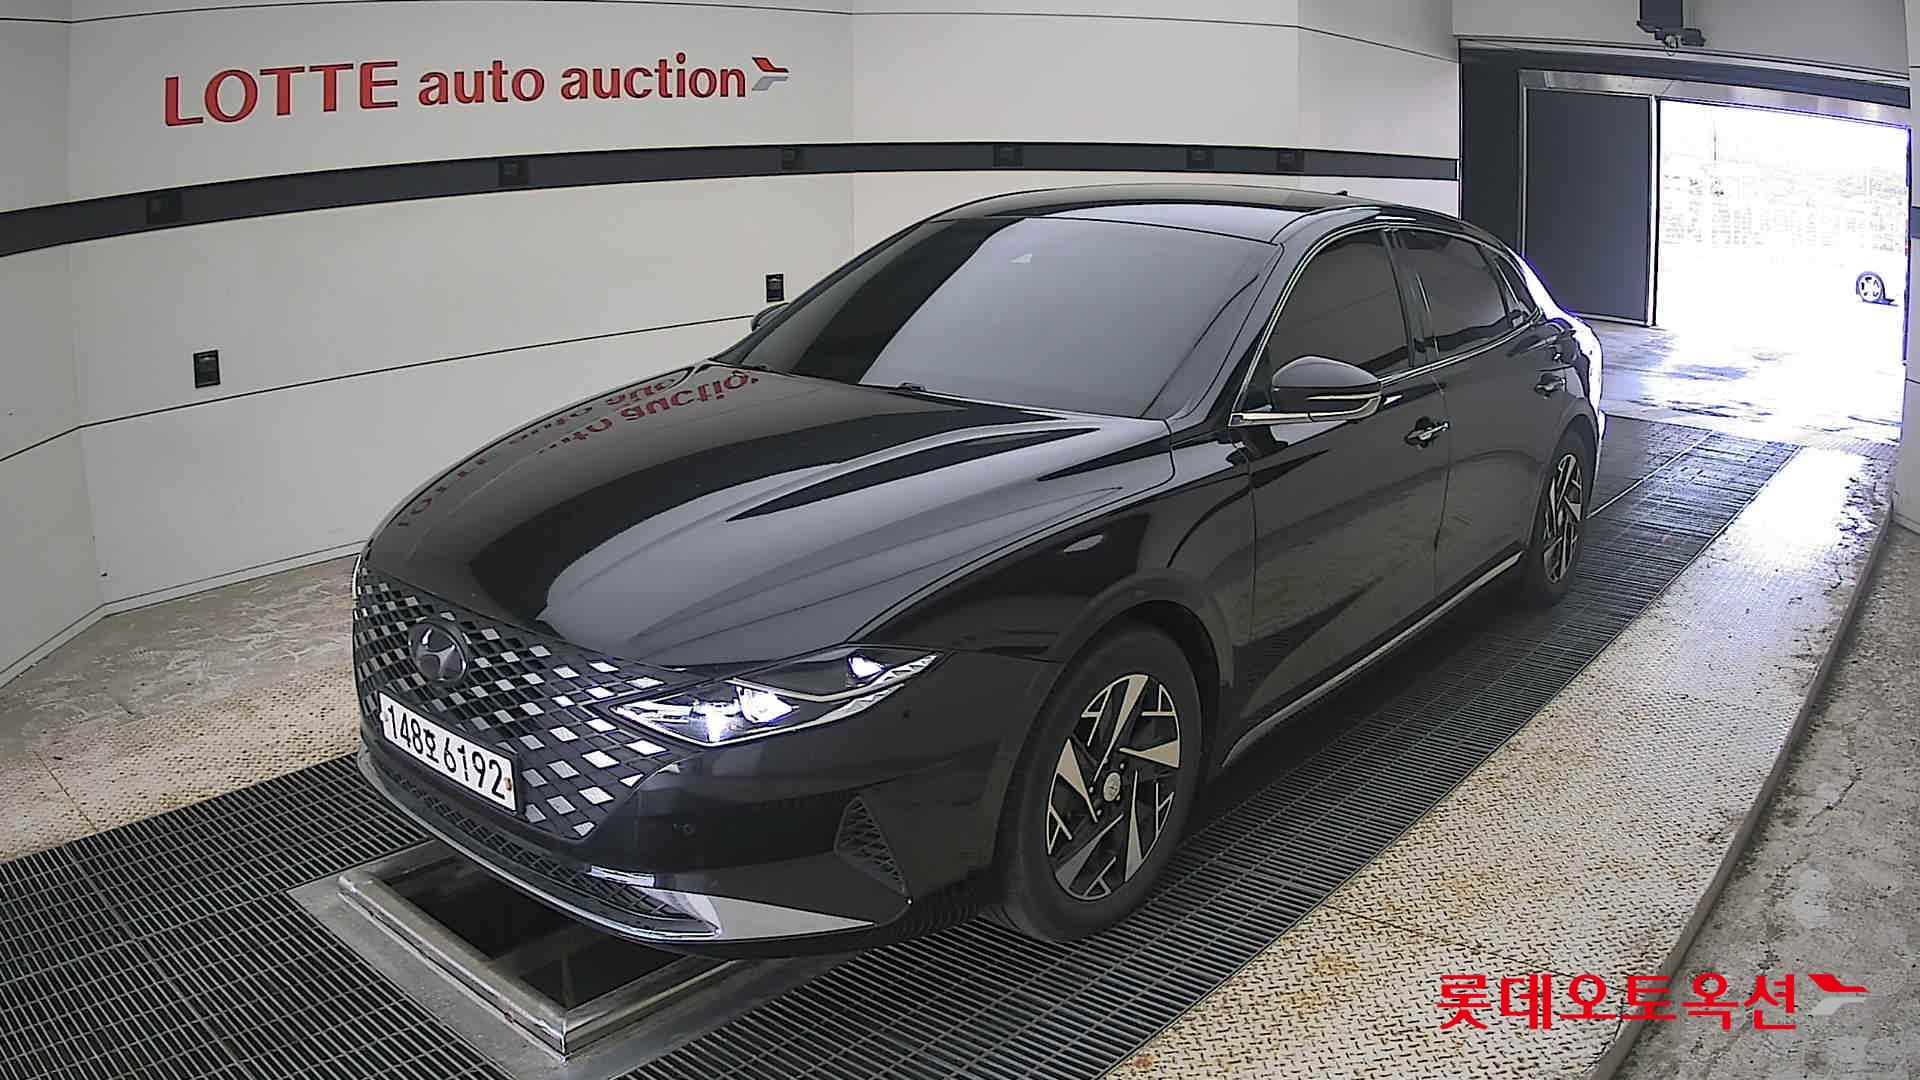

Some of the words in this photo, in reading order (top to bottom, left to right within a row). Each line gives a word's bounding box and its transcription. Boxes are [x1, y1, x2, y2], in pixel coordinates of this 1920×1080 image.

[164, 60, 399, 127] LOTTE
[417, 60, 545, 106] auto
[561, 52, 747, 101] auction
